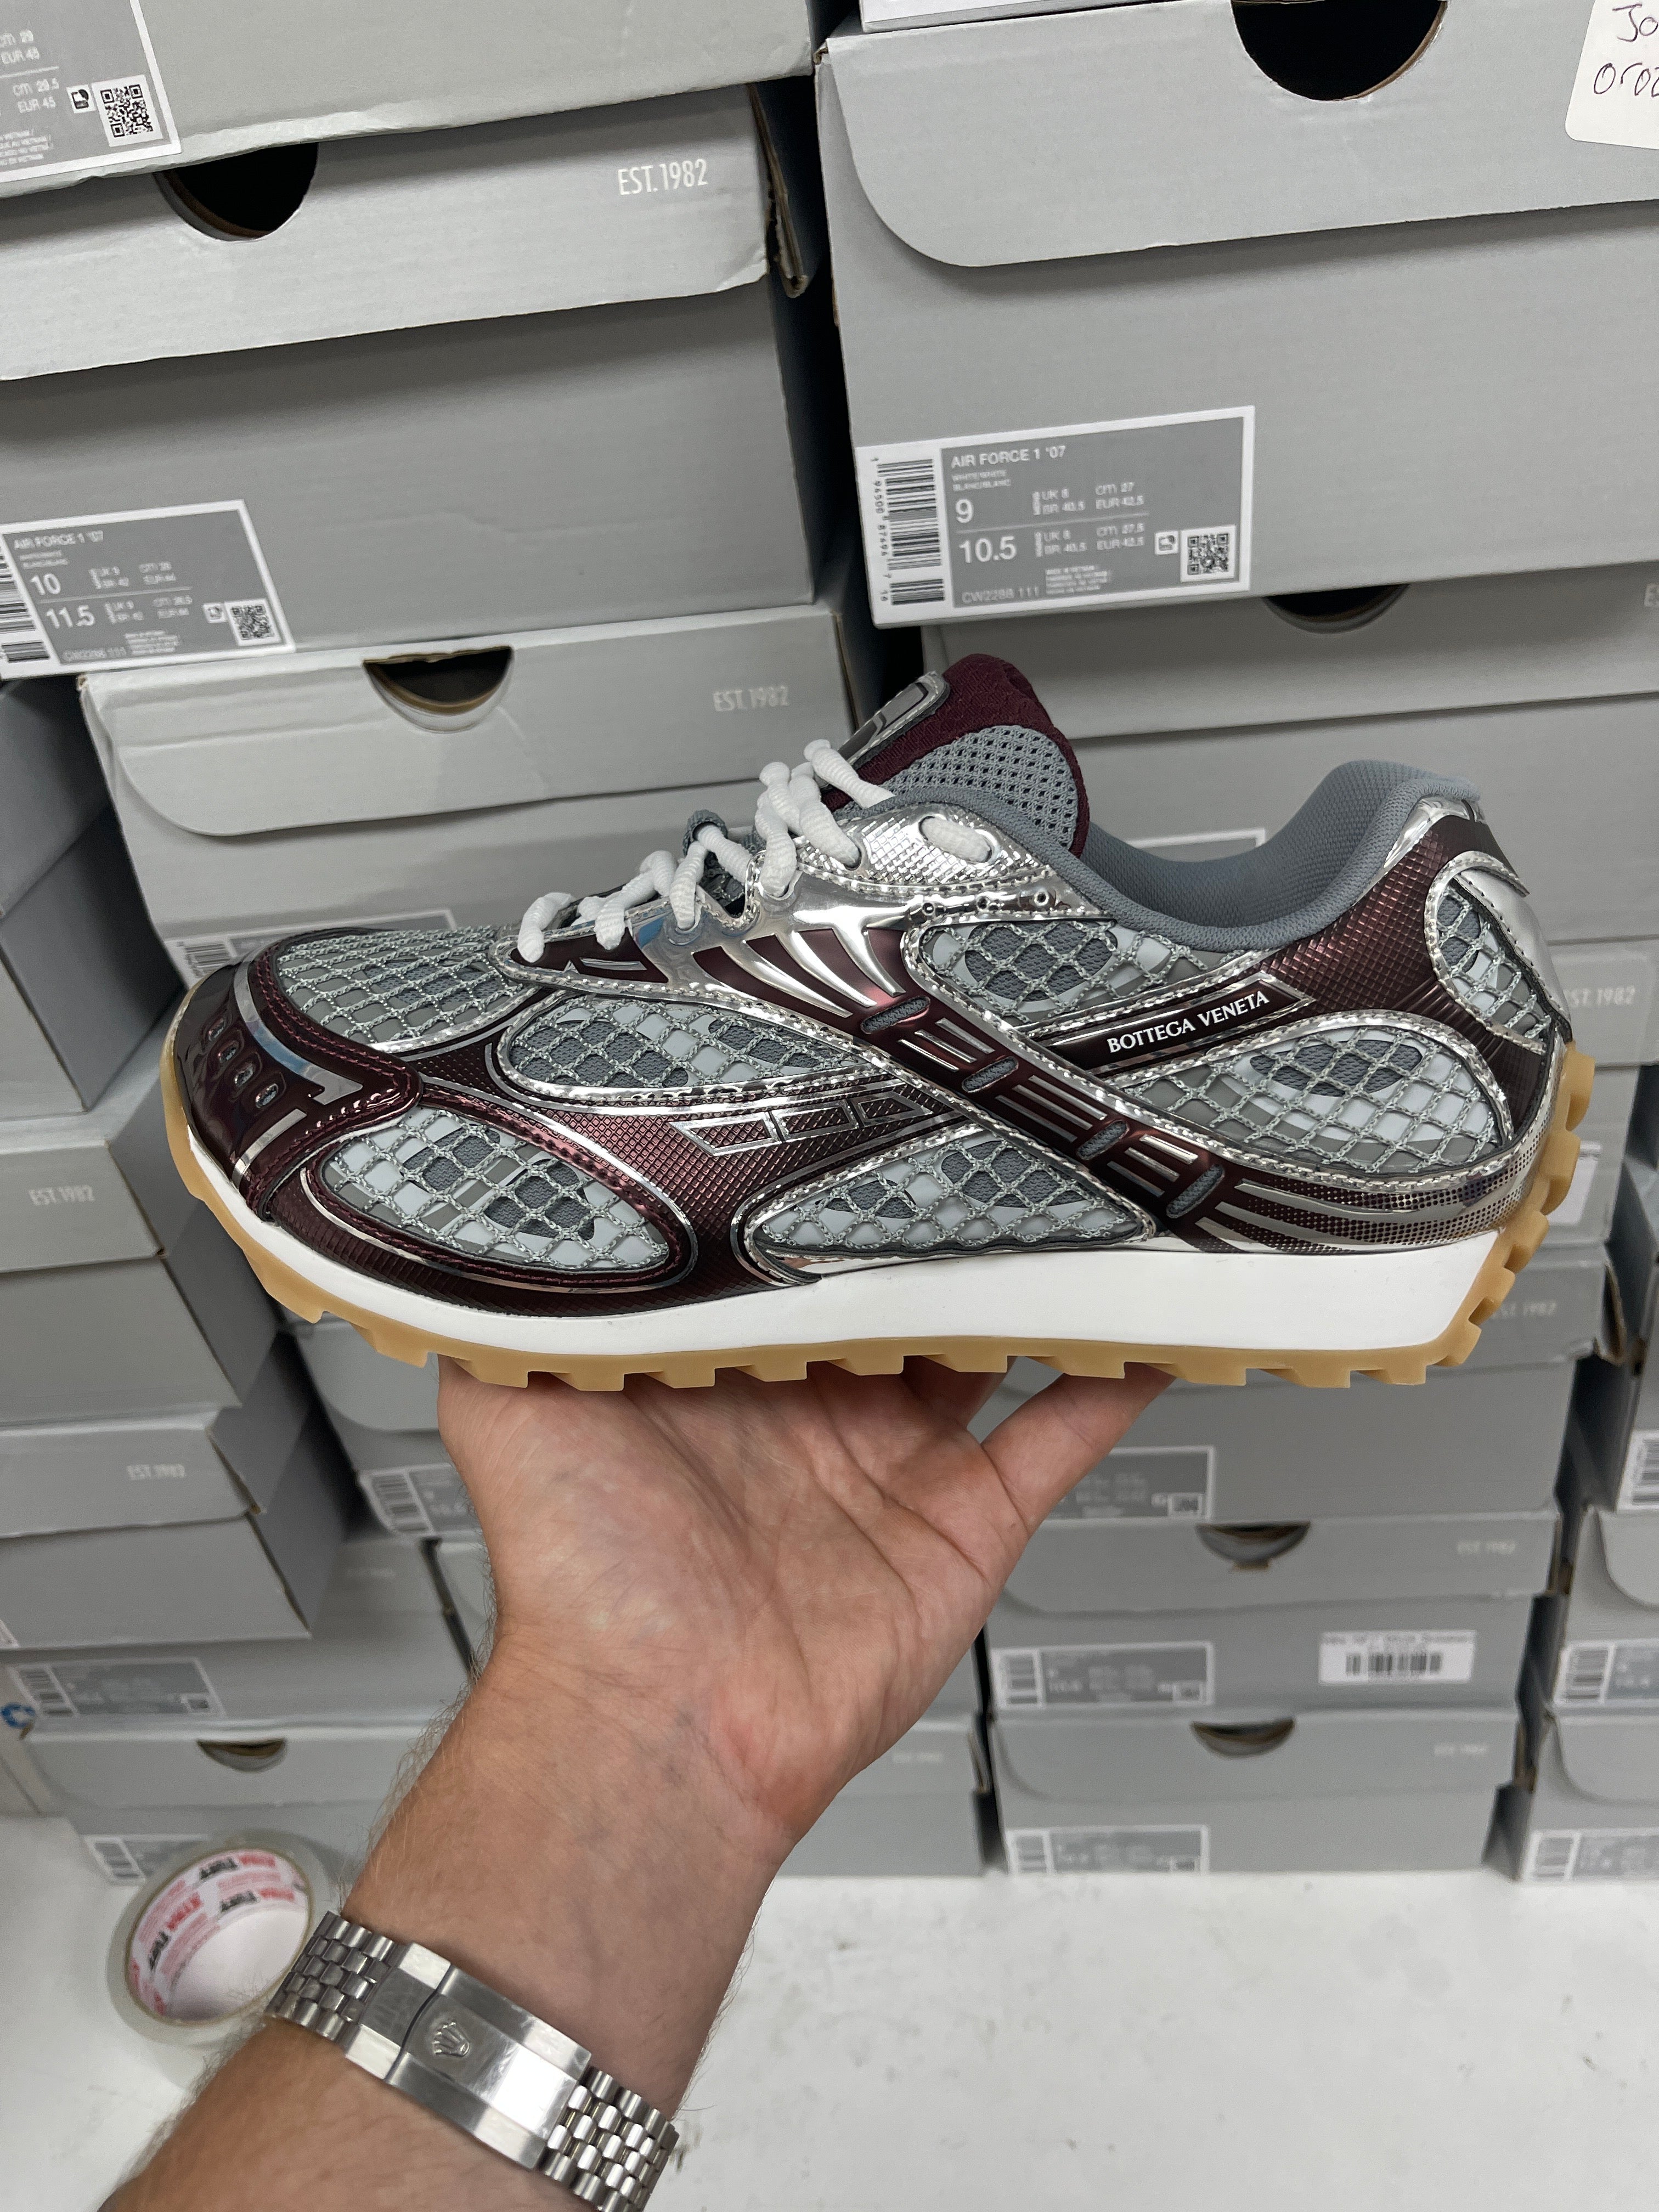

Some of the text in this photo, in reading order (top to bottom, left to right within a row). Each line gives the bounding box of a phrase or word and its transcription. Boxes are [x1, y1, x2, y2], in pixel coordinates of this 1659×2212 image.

[951, 454, 977, 469] AIR
[979, 449, 1030, 465] FORCE
[1034, 448, 1040, 460] 1
[955, 499, 974, 523] 9
[959, 536, 1017, 563] 10.5
[31, 573, 62, 596] 10
[47, 605, 95, 629] 11.5
[1107, 991, 1270, 1053] BOTTEGA VENETA
